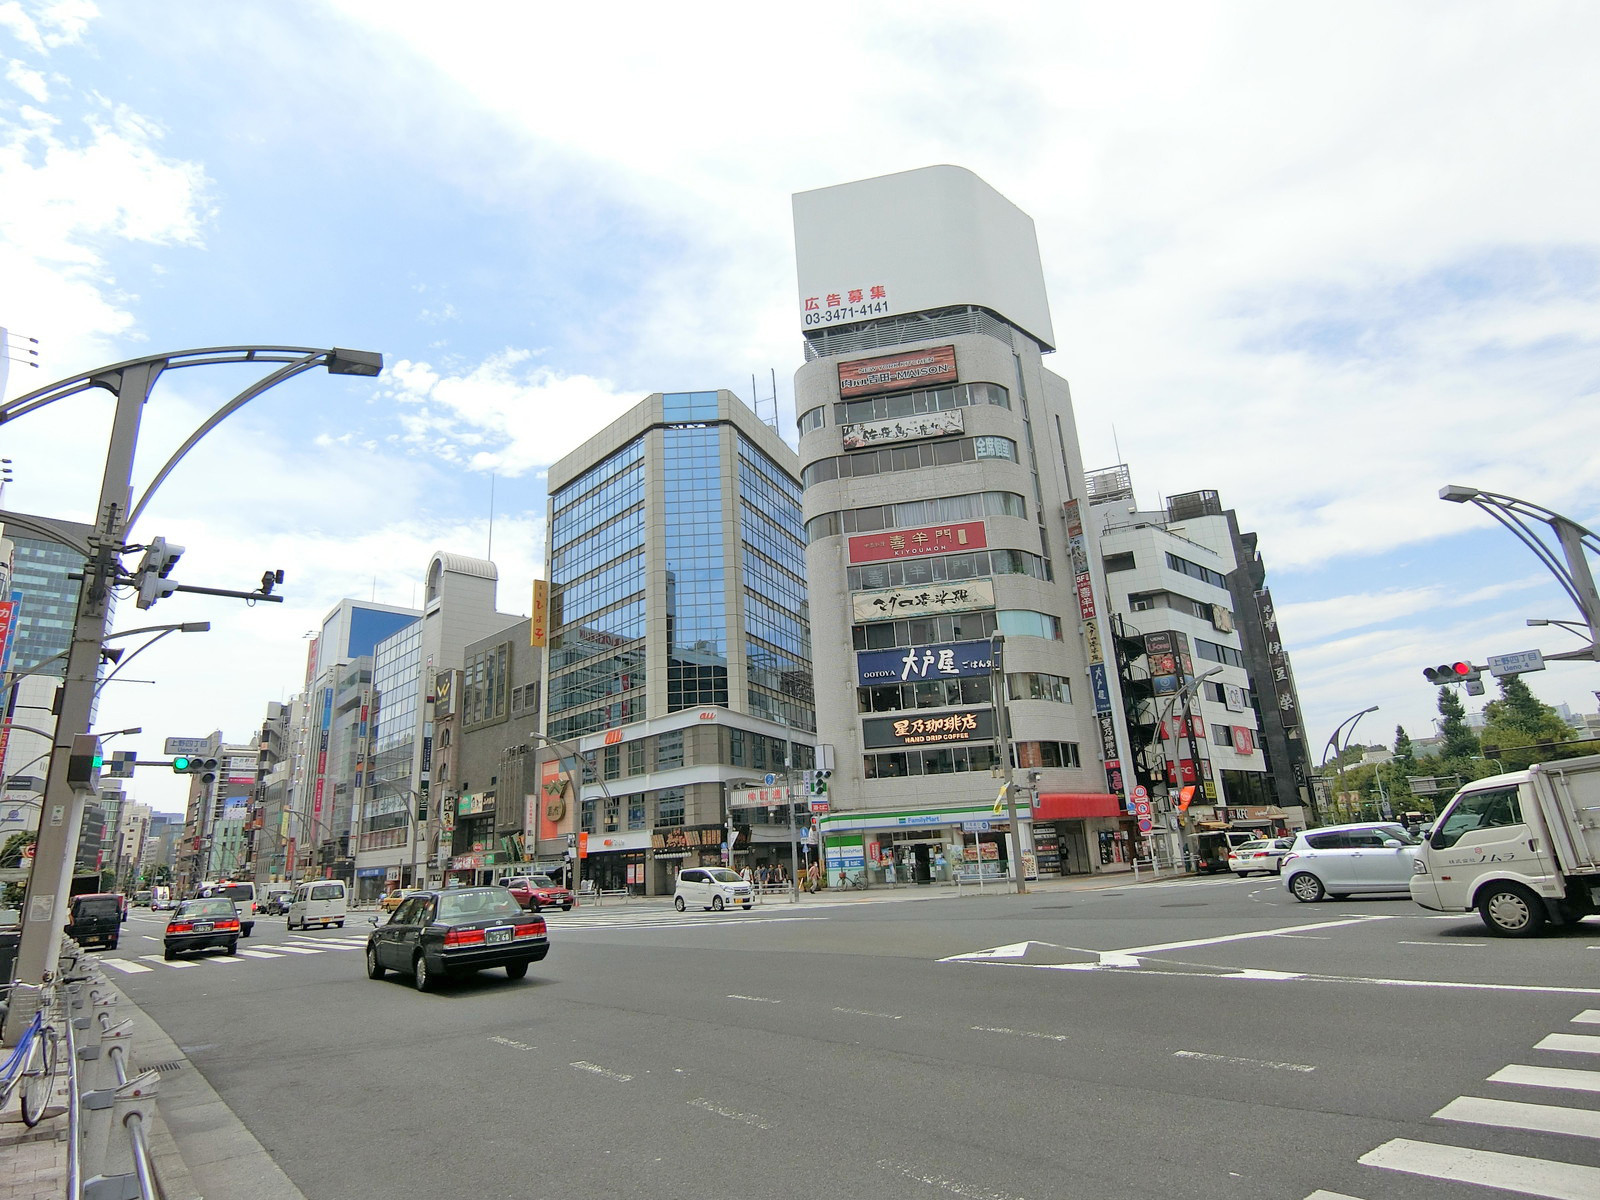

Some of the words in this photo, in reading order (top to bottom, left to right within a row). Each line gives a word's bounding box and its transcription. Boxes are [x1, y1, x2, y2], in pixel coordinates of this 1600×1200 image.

[804, 285, 887, 311] 広告募集
[805, 302, 889, 325] 03-3471-4141
[894, 545, 946, 556] KIYOUMON
[901, 648, 959, 680] 大戸屋
[1493, 653, 1537, 666] 上野四丁目
[1504, 664, 1522, 672] Ueno
[863, 671, 895, 679] OOTOYA
[700, 712, 716, 720] au
[893, 713, 977, 737] 星乃珈琲店
[604, 729, 624, 745] au
[1236, 808, 1249, 819] KFC
[907, 816, 940, 824] FamilyMart
[1480, 852, 1515, 863] ノムラ
